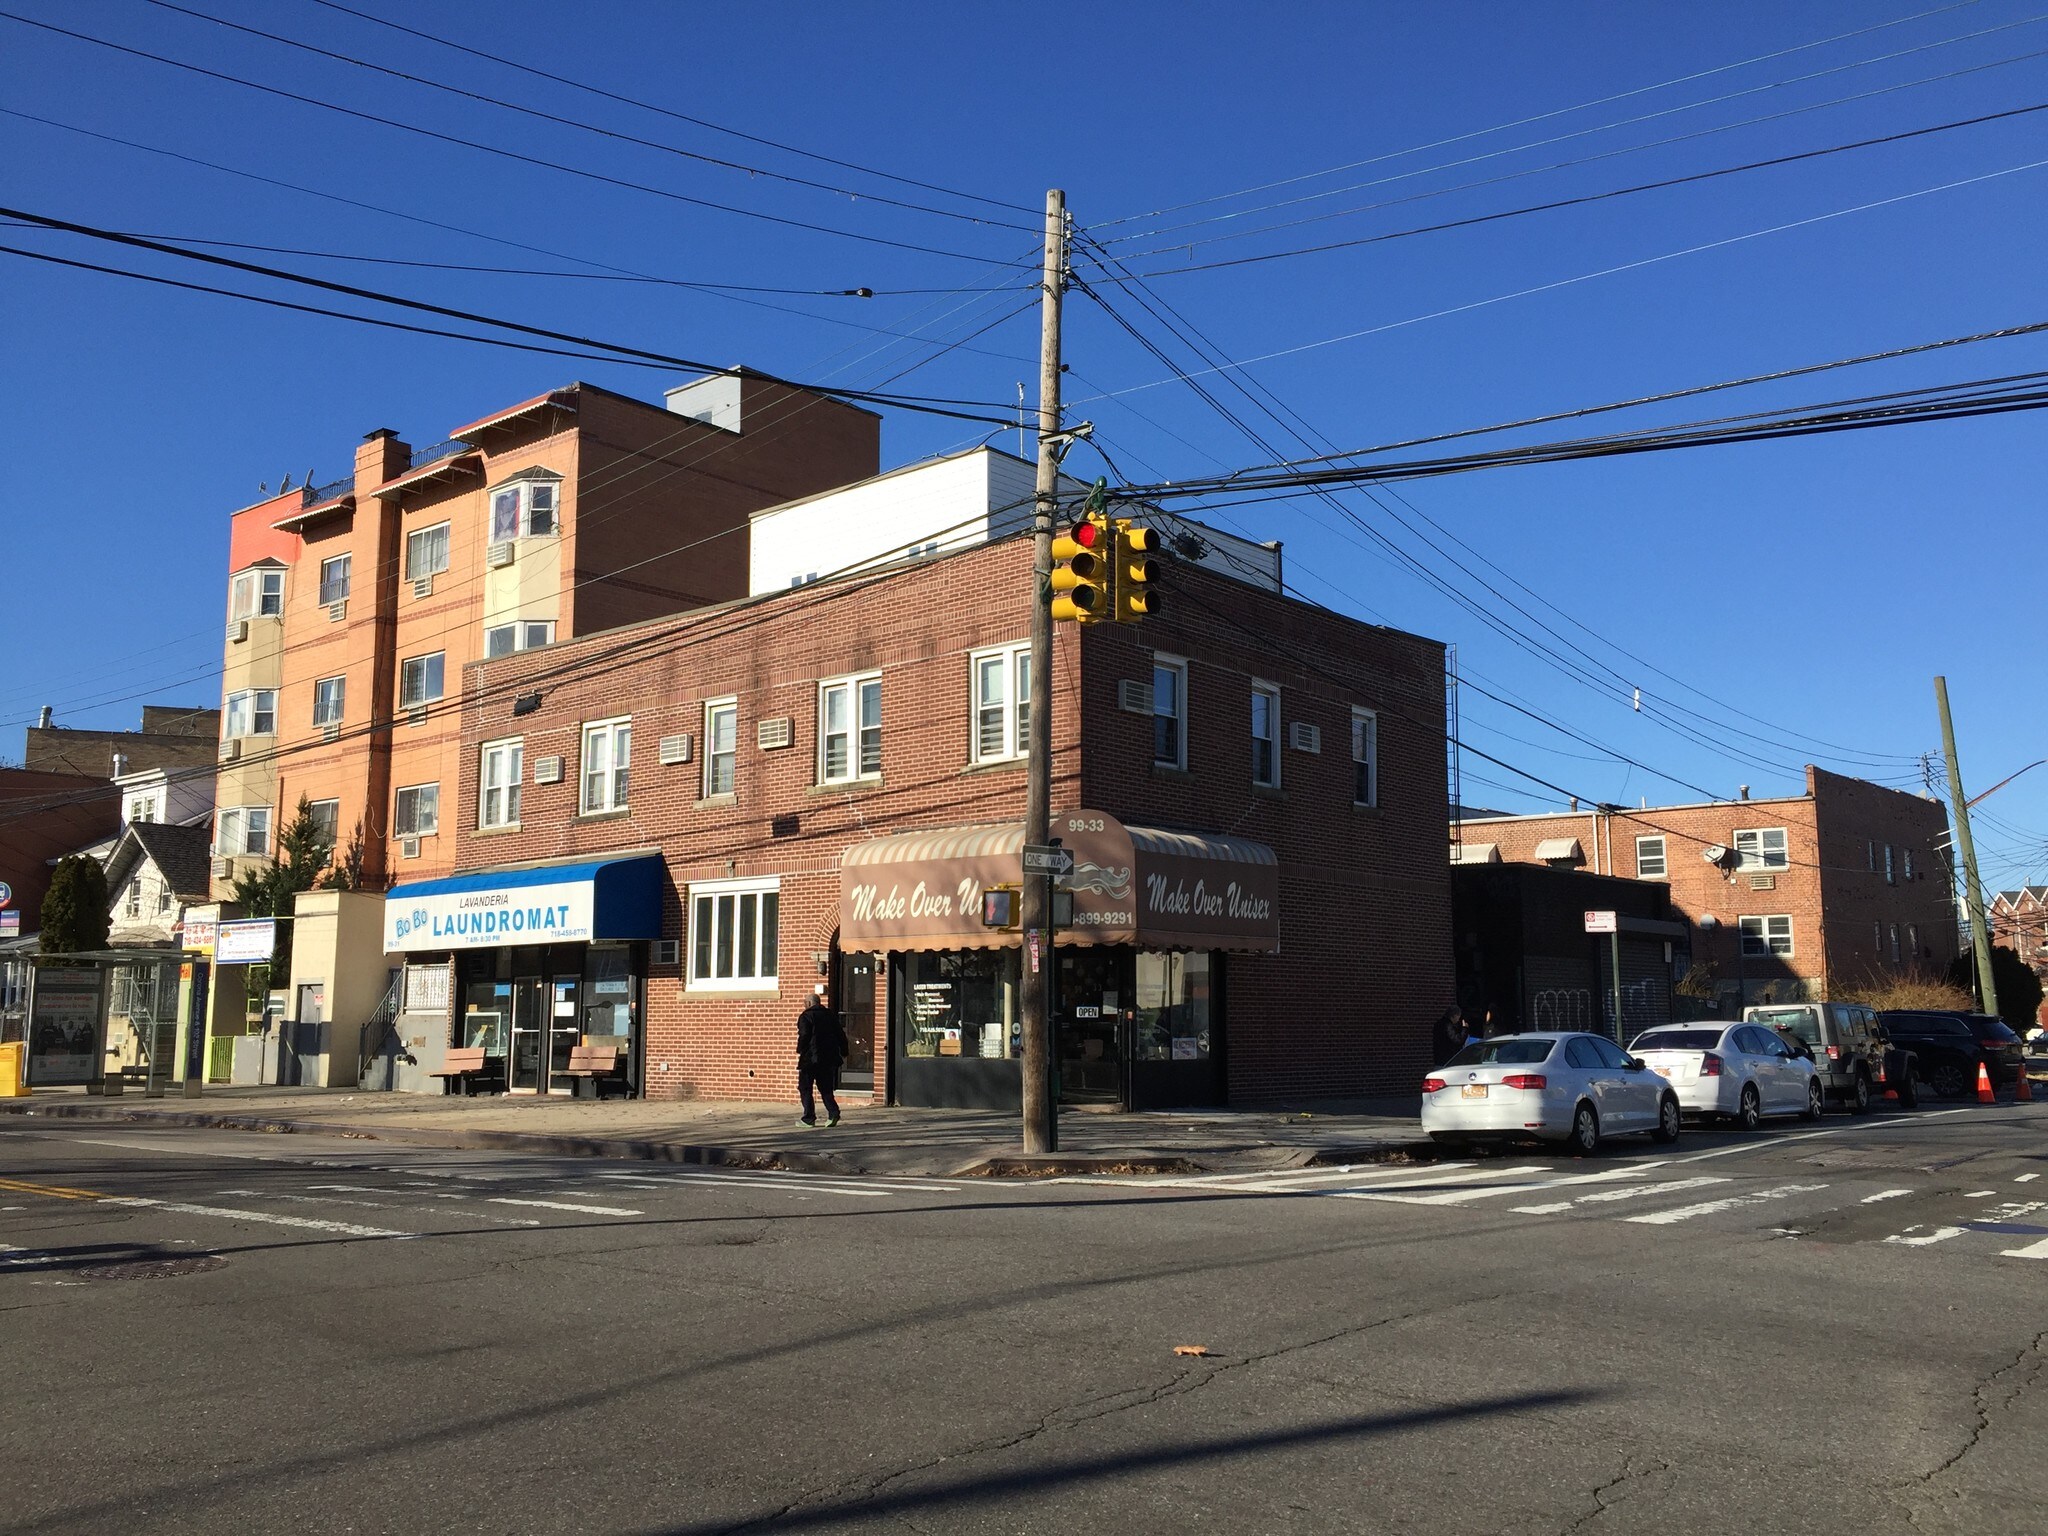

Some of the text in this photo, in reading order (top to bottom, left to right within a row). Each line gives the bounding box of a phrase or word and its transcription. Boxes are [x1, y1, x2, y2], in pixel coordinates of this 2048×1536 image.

[1026, 853, 1068, 868] ONE WAY
[459, 894, 509, 909] LAVANDERIA
[851, 884, 905, 921] Make
[910, 880, 952, 918] Over
[1147, 872, 1270, 919] Make Over Unisex
[433, 905, 569, 937] LAUNDROMAT
[1072, 911, 1133, 925] -899-9291
[1078, 1007, 1098, 1017] OPEN
